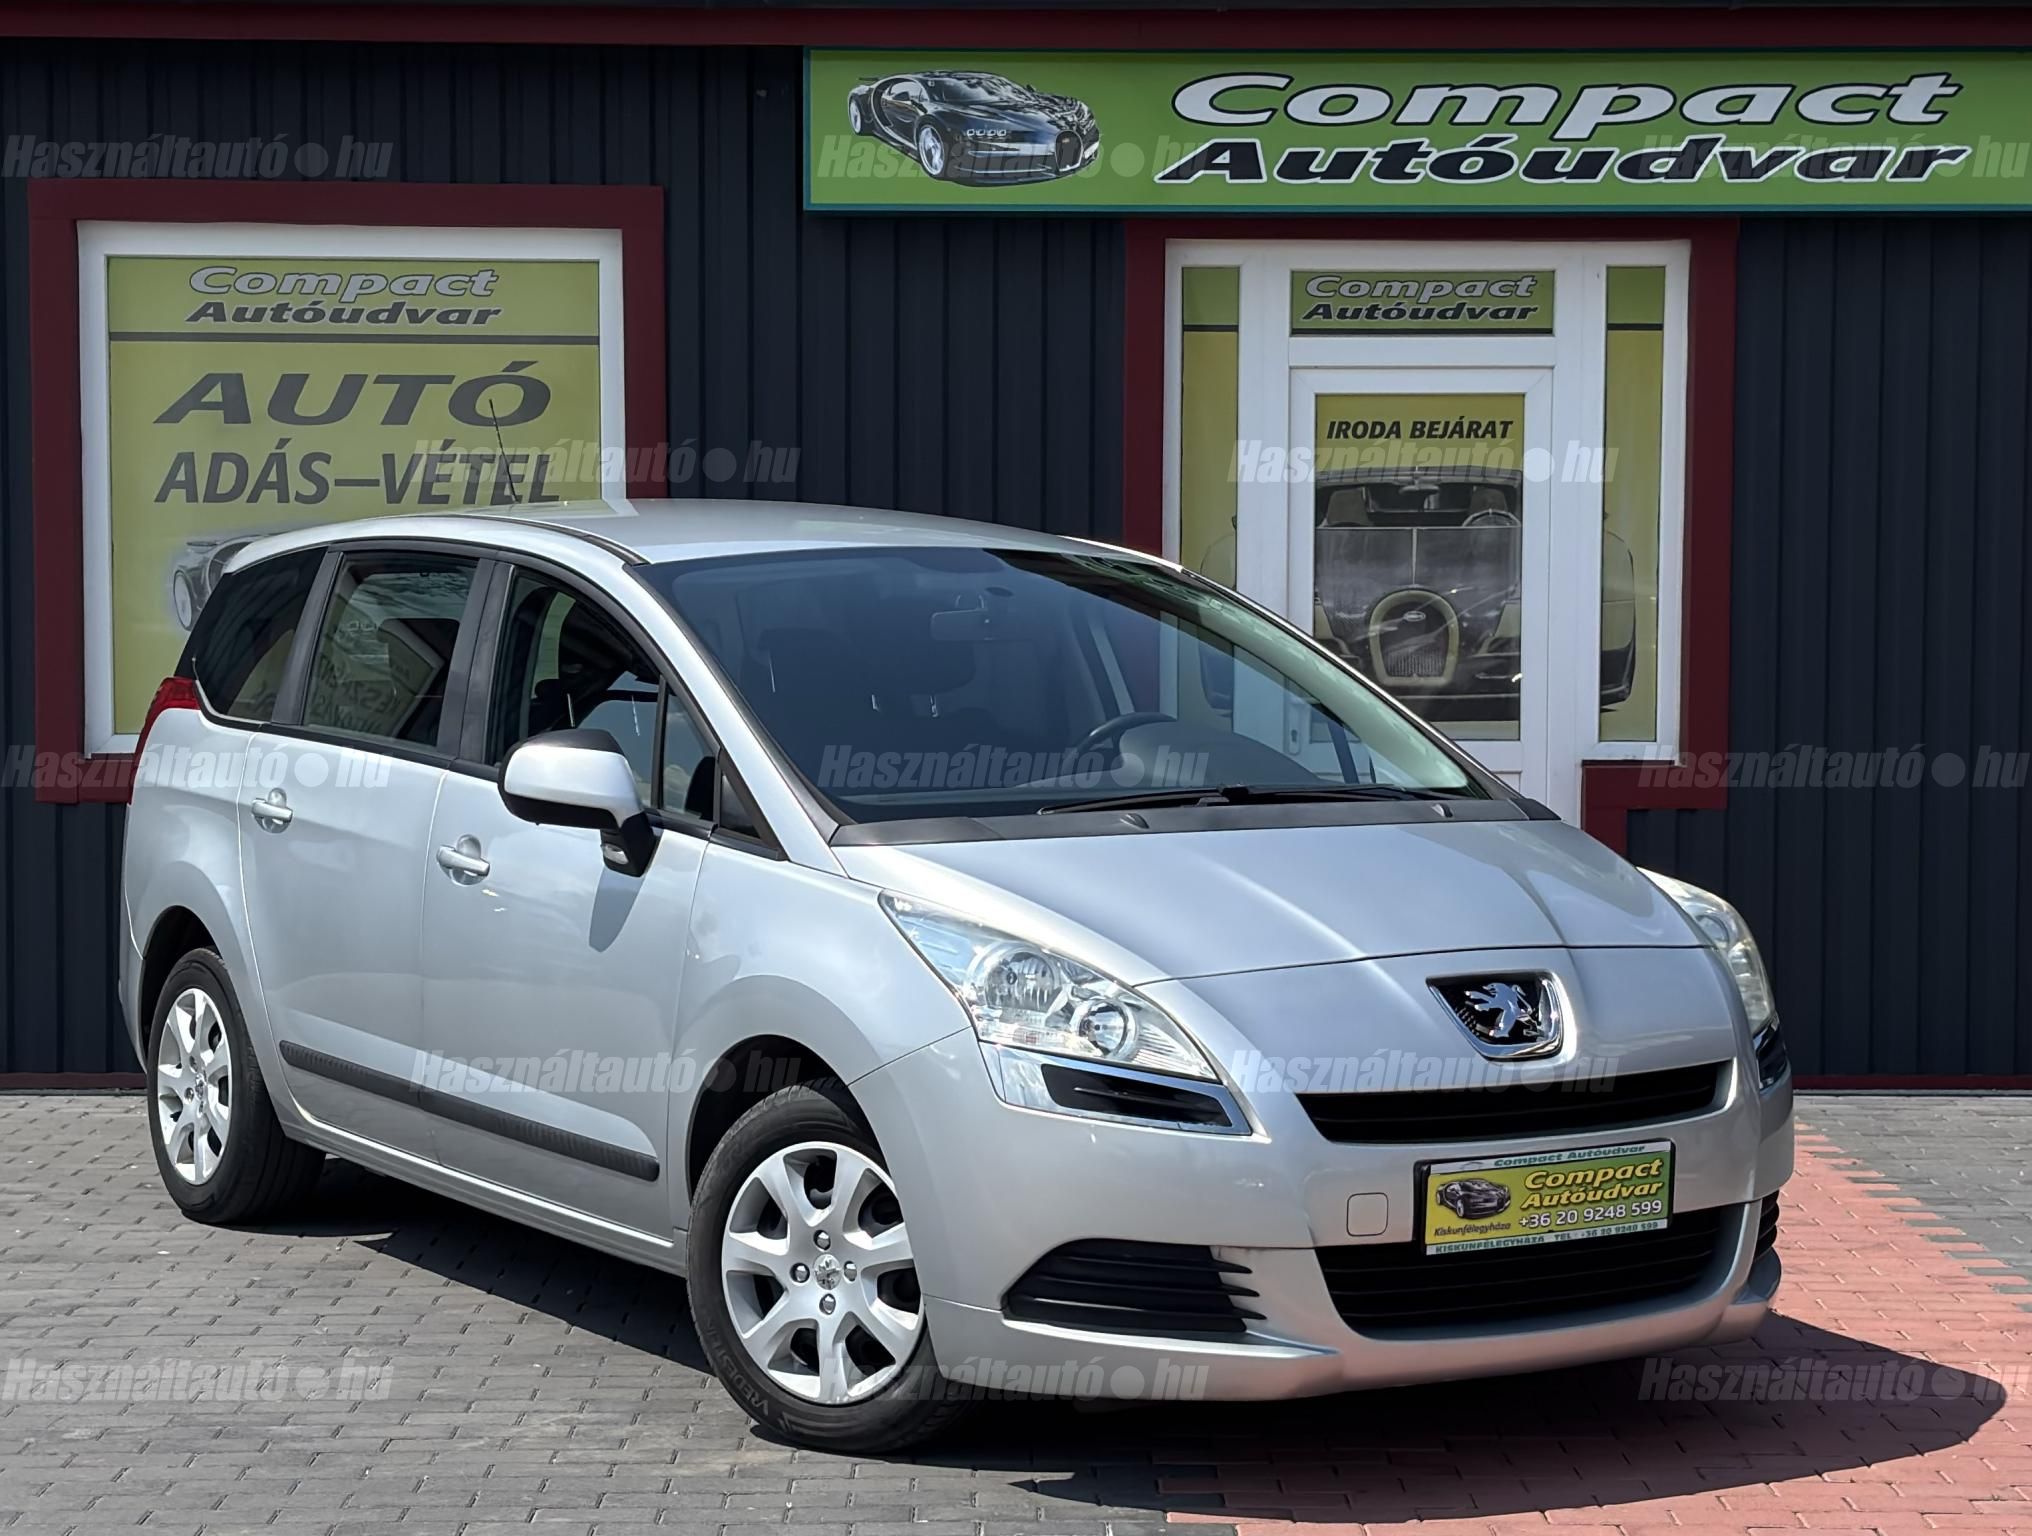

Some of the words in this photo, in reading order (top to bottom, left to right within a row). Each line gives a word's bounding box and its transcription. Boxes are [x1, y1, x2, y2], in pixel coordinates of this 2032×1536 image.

[1171, 71, 1963, 141] Compact
[1154, 133, 1972, 184] Autóudvar
[189, 266, 499, 303] Compact
[1305, 275, 1538, 304] Compact
[185, 300, 502, 325] Autóudvar
[1302, 301, 1539, 322] Autóudvar
[153, 361, 551, 426] AUTÓ
[1327, 420, 1401, 439] IRODA
[1409, 416, 1514, 439] BEJÁRAT
[1494, 1152, 1563, 1168] Compact
[1524, 1157, 1663, 1190] Compact
[1520, 1180, 1663, 1210] Autóudvar
[1519, 1212, 1550, 1228] +36
[1556, 1209, 1578, 1225] 20
[1584, 1204, 1626, 1222] 9248
[1631, 1199, 1662, 1217] 599
[1434, 1221, 1511, 1237] Kiskunfélegyháza
